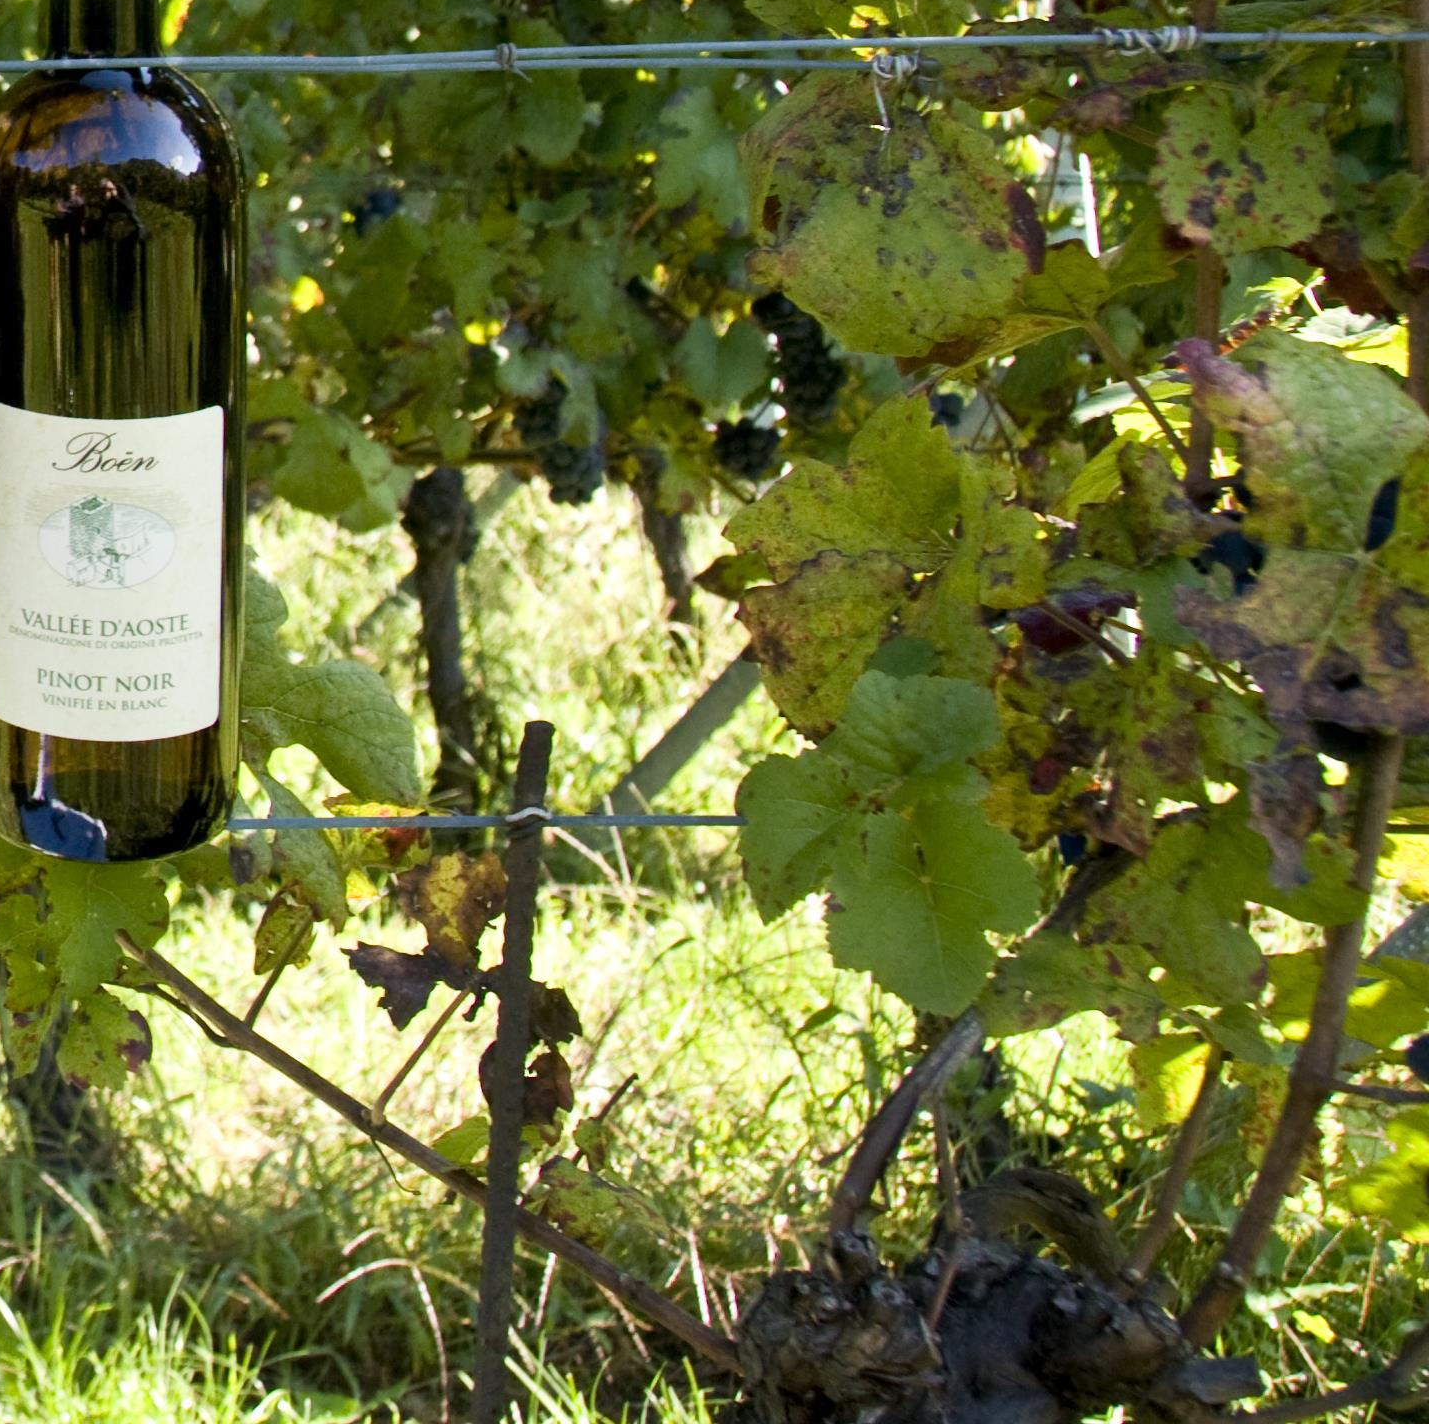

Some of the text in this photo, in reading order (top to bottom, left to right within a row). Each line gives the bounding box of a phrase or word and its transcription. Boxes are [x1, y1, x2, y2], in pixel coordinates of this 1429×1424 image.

[52, 431, 160, 474] Boën
[21, 608, 189, 637] VALLÉE D'AOSTE
[111, 638, 156, 649] ORIGINE
[36, 667, 175, 693] PINOT NOIR
[42, 692, 168, 711] VINIFIÉ EN BLANC
